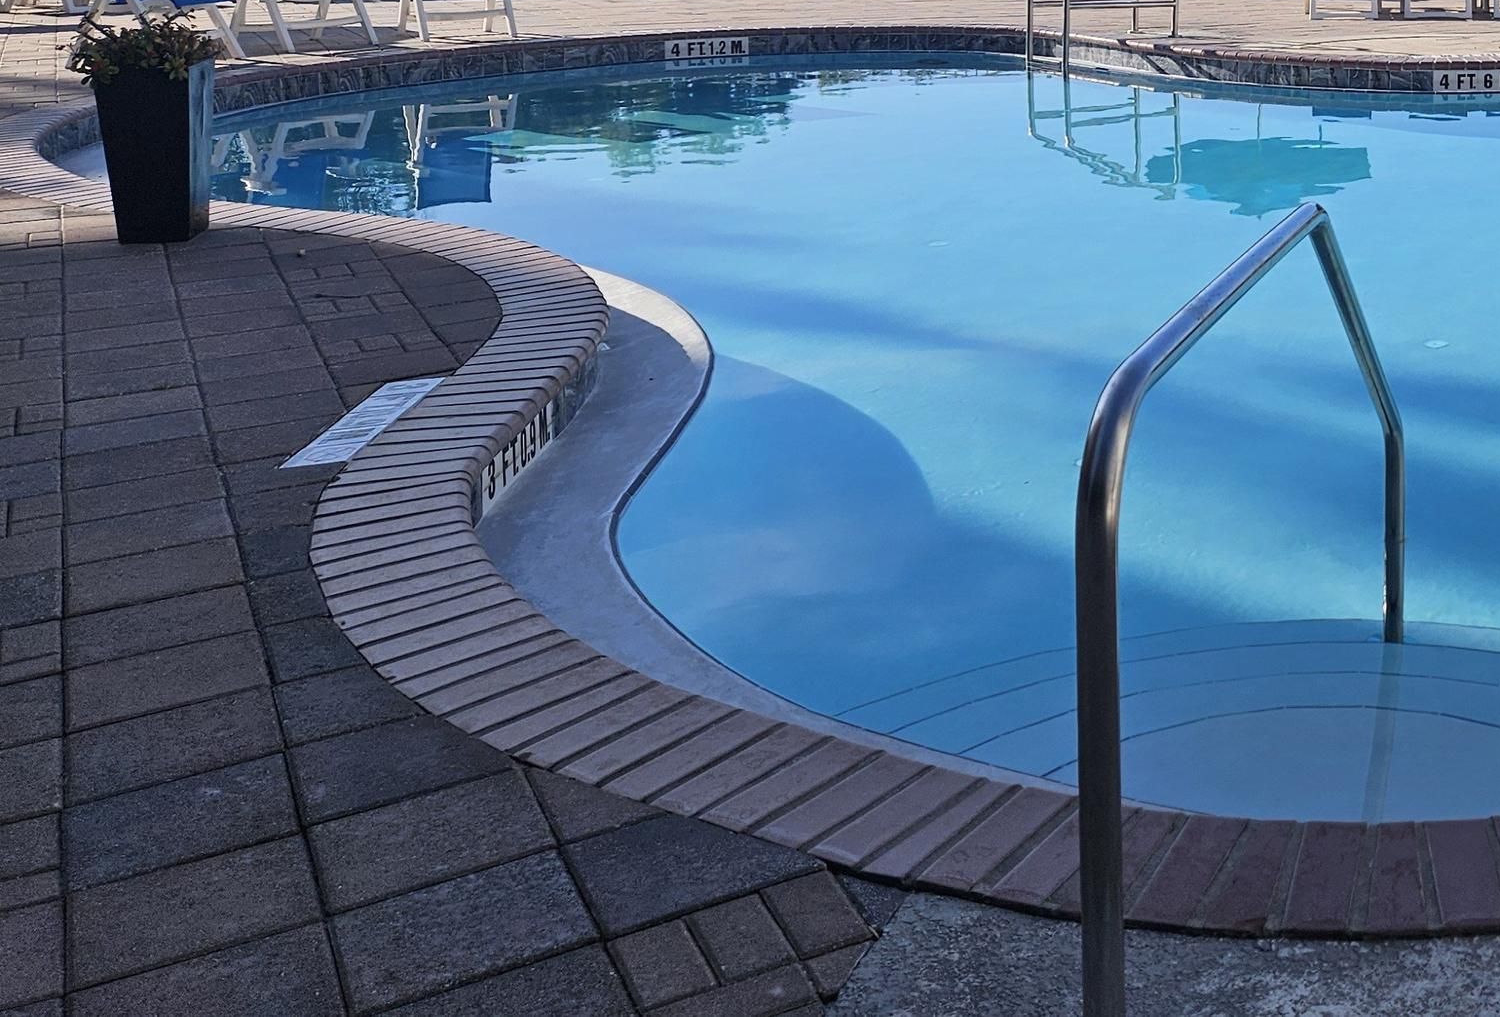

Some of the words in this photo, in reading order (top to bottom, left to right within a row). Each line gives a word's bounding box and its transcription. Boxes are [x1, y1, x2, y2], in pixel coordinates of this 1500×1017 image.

[671, 43, 680, 57] 4
[730, 40, 746, 54] M.
[1440, 75, 1450, 89] 4
[1457, 73, 1476, 89] FT.
[1484, 73, 1492, 89] 6
[488, 459, 496, 500] 3
